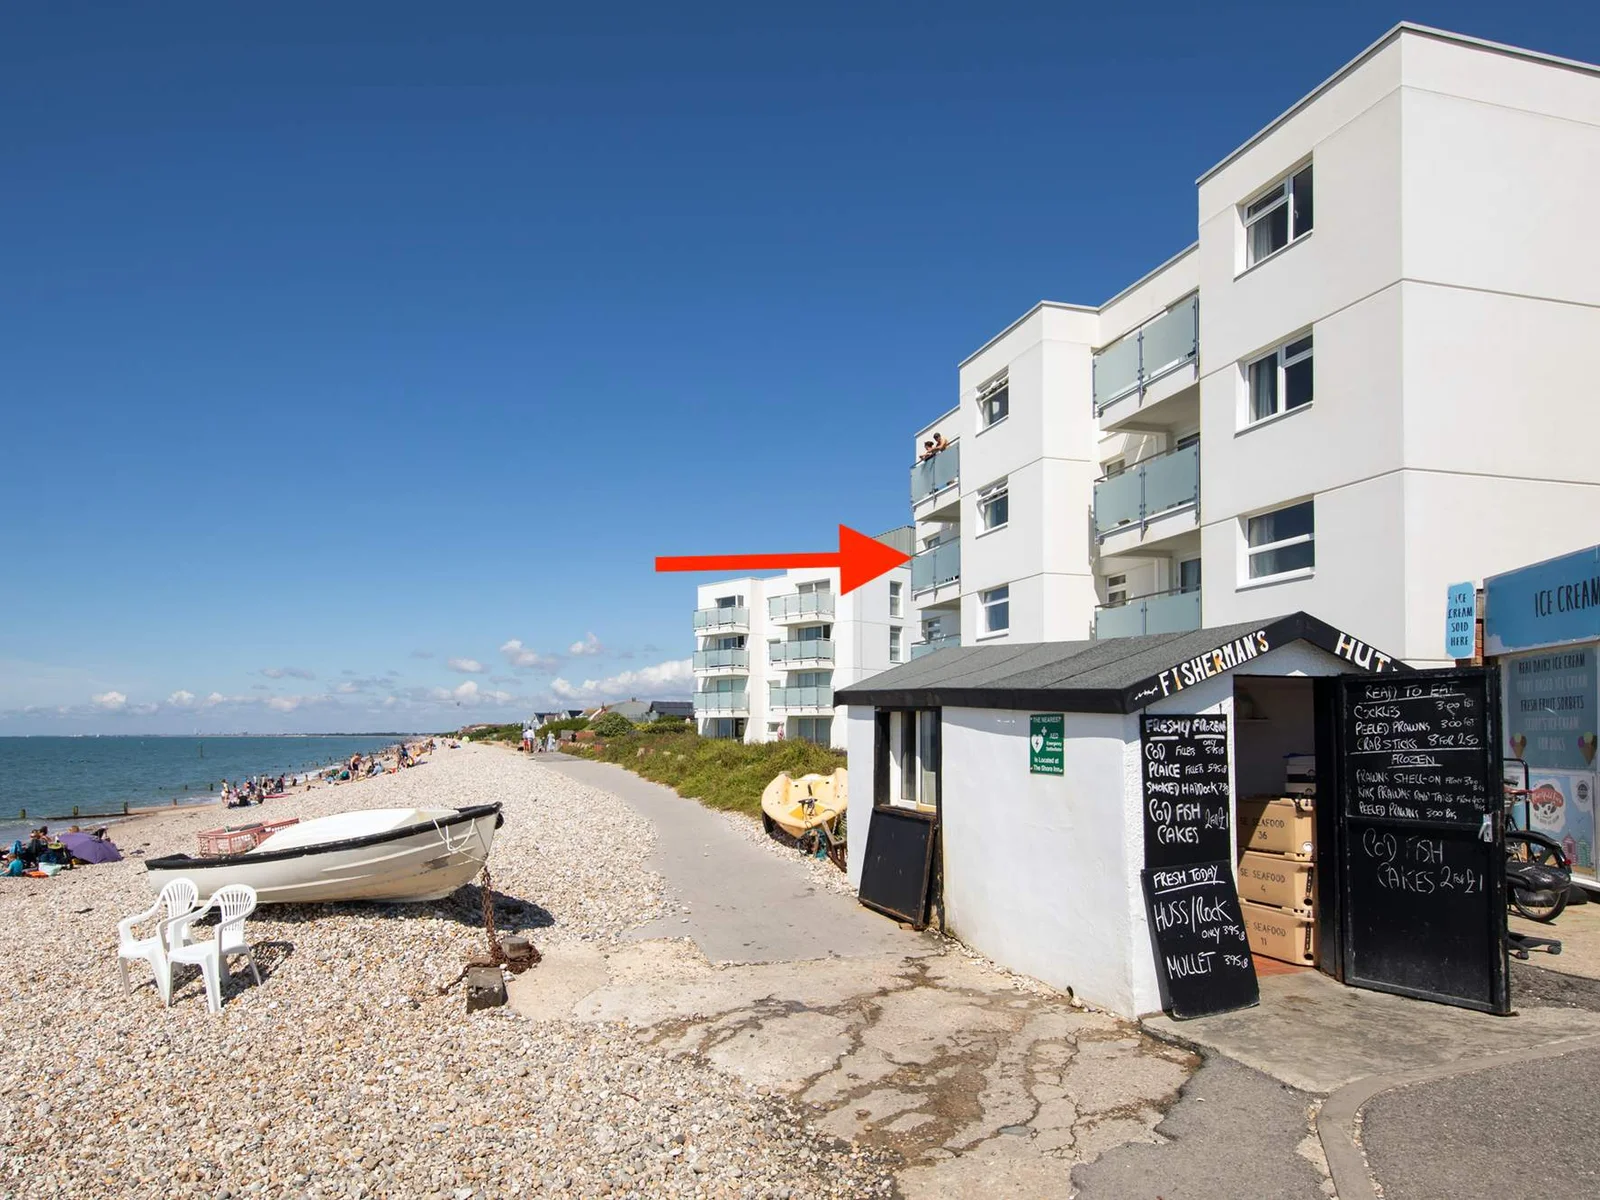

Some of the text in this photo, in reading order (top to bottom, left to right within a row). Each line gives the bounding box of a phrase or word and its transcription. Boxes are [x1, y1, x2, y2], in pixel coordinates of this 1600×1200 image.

[1455, 593, 1467, 604] ICE
[1535, 590, 1552, 618] ICE
[1447, 607, 1473, 619] CREAM
[1450, 637, 1468, 646] HERE
[1158, 630, 1392, 696] FISHERMAN'S HUT
[1552, 655, 1562, 670] ICE
[1564, 652, 1585, 669] CREAM
[1403, 685, 1422, 697] TO
[1430, 681, 1460, 697] EAT
[1353, 705, 1401, 719] COCKLES
[1520, 700, 1538, 712] FRESH
[1557, 695, 1584, 710] SORBETS
[1145, 718, 1226, 738] FRESHLY FROZEN
[1355, 721, 1389, 736] PEELED
[1392, 720, 1431, 734] PRAWNS
[1427, 733, 1440, 746] 8
[1440, 735, 1454, 746] FOR
[1145, 742, 1166, 760] COD
[1391, 753, 1436, 765] FROZEN
[1148, 761, 1180, 778] PLAICE
[1356, 769, 1389, 784] PRAWNS
[1393, 773, 1441, 786] SHELL-ON
[1146, 781, 1180, 796] SMOKED
[1181, 781, 1219, 796] HADDOCK
[1377, 785, 1410, 800] PRAWNS
[1149, 798, 1171, 825] COD
[1176, 803, 1201, 822] FISH
[1359, 801, 1386, 817] PEELED
[1388, 802, 1419, 819] PRAWNS
[1157, 825, 1199, 845] CAKES
[1363, 828, 1443, 863] COD FISH
[1153, 865, 1218, 889] FRESH TODAY
[1252, 869, 1286, 884] SEAFOOD
[1377, 862, 1435, 894] CAKES
[1201, 927, 1220, 944] ONLY
[1253, 921, 1286, 937] SEAFOOD
[1166, 951, 1216, 980] MULLET
